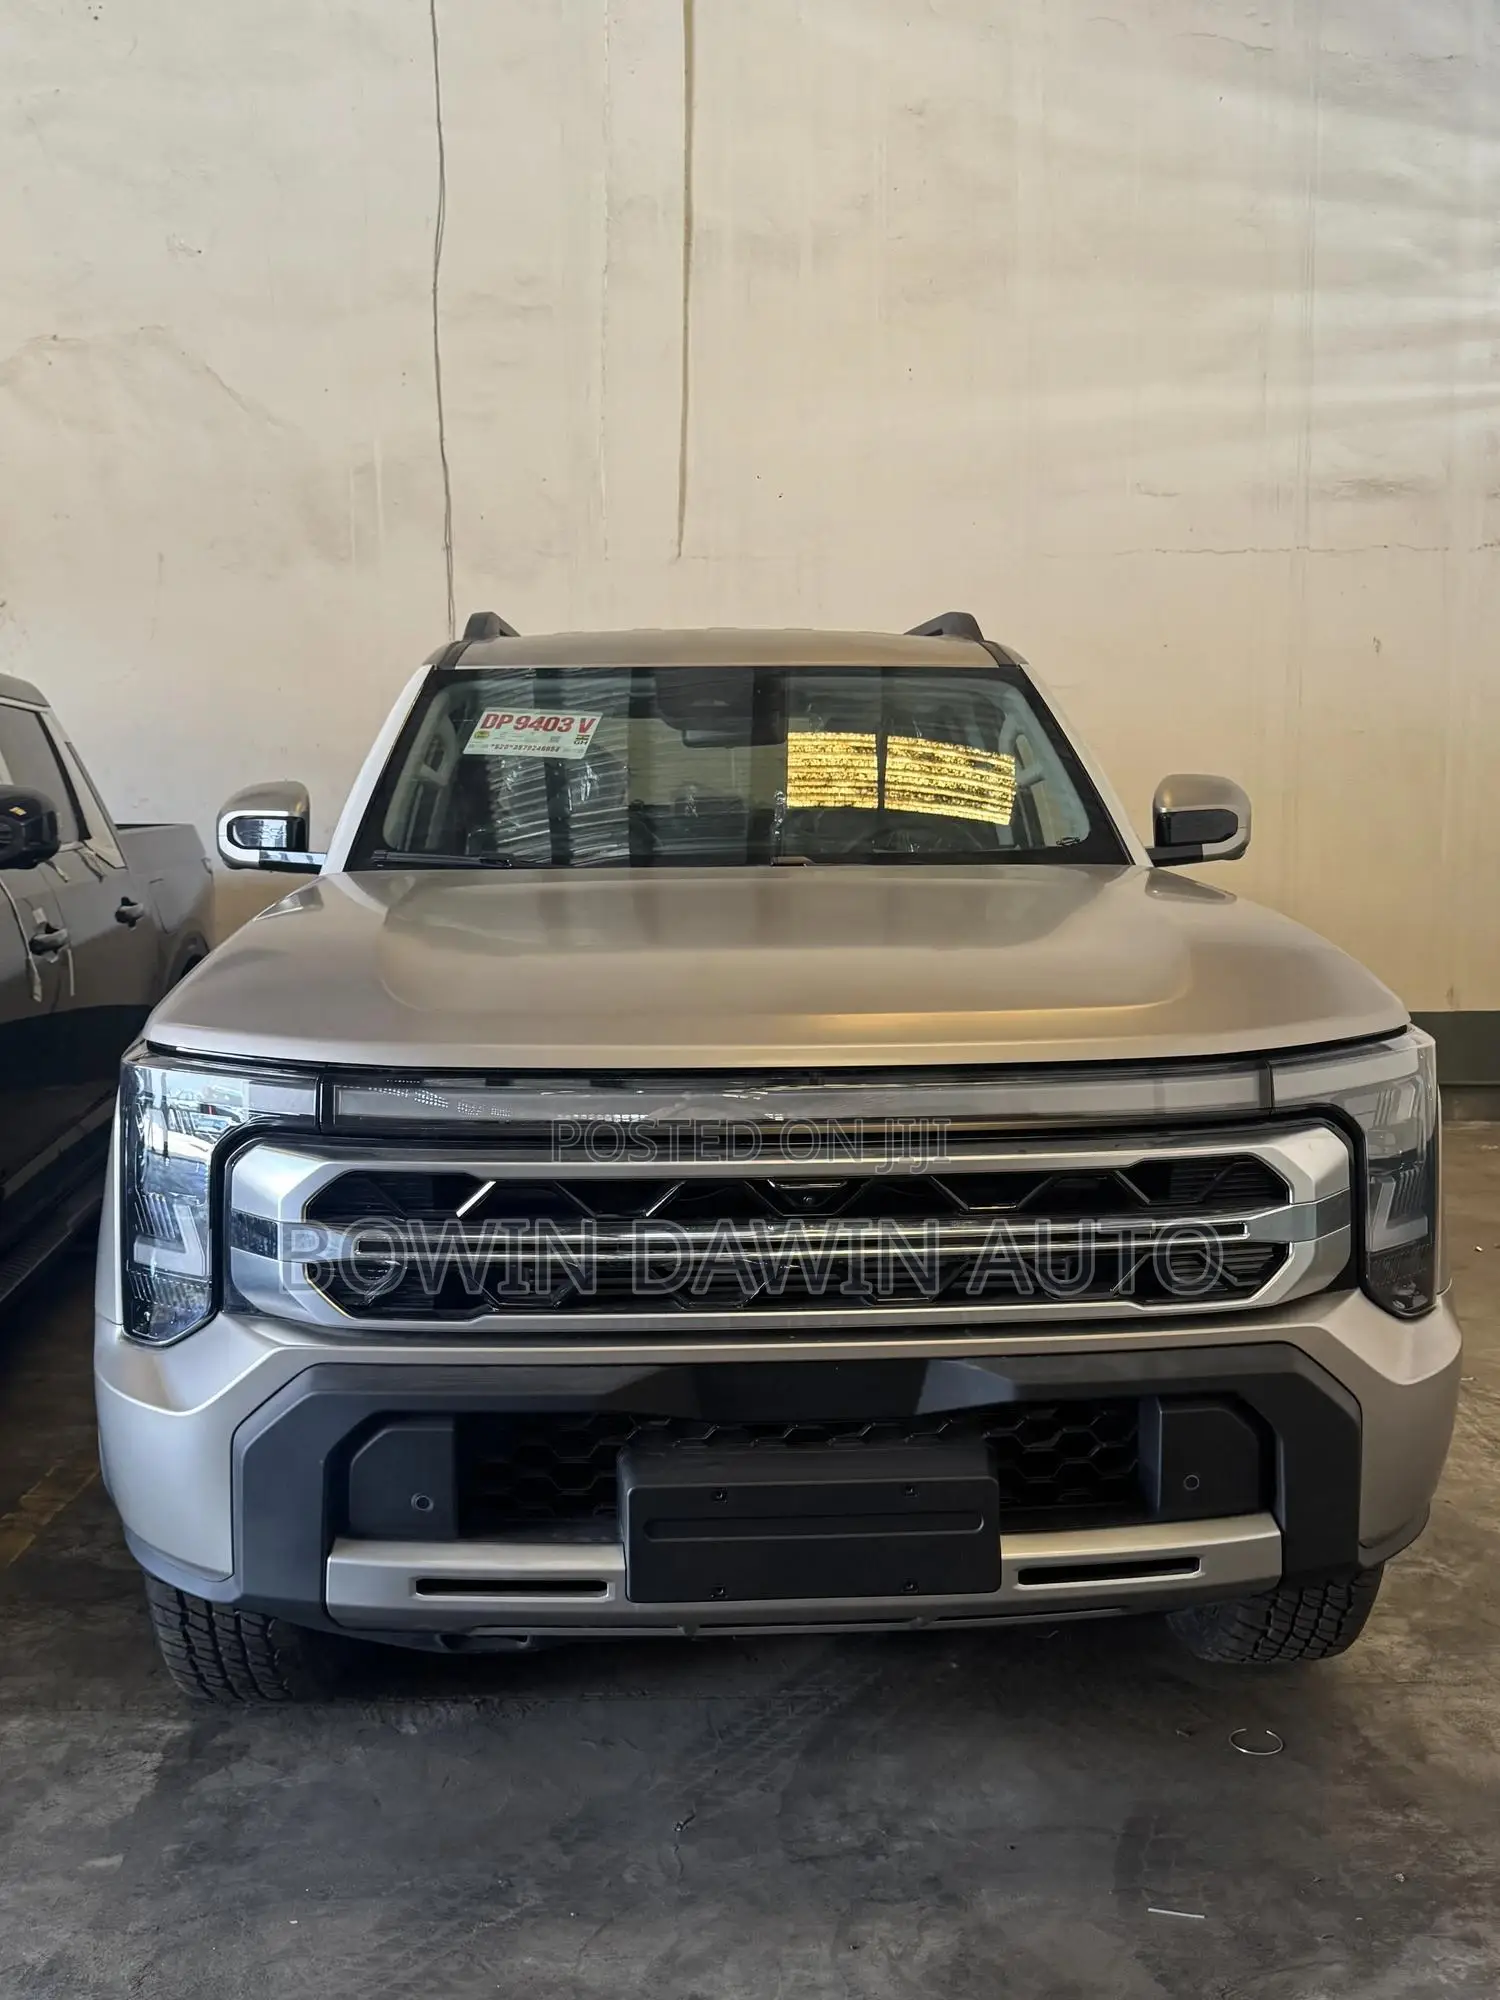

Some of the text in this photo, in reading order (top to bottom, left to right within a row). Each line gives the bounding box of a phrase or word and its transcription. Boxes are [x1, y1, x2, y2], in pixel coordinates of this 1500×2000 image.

[480, 713, 597, 733] DP 9403 V
